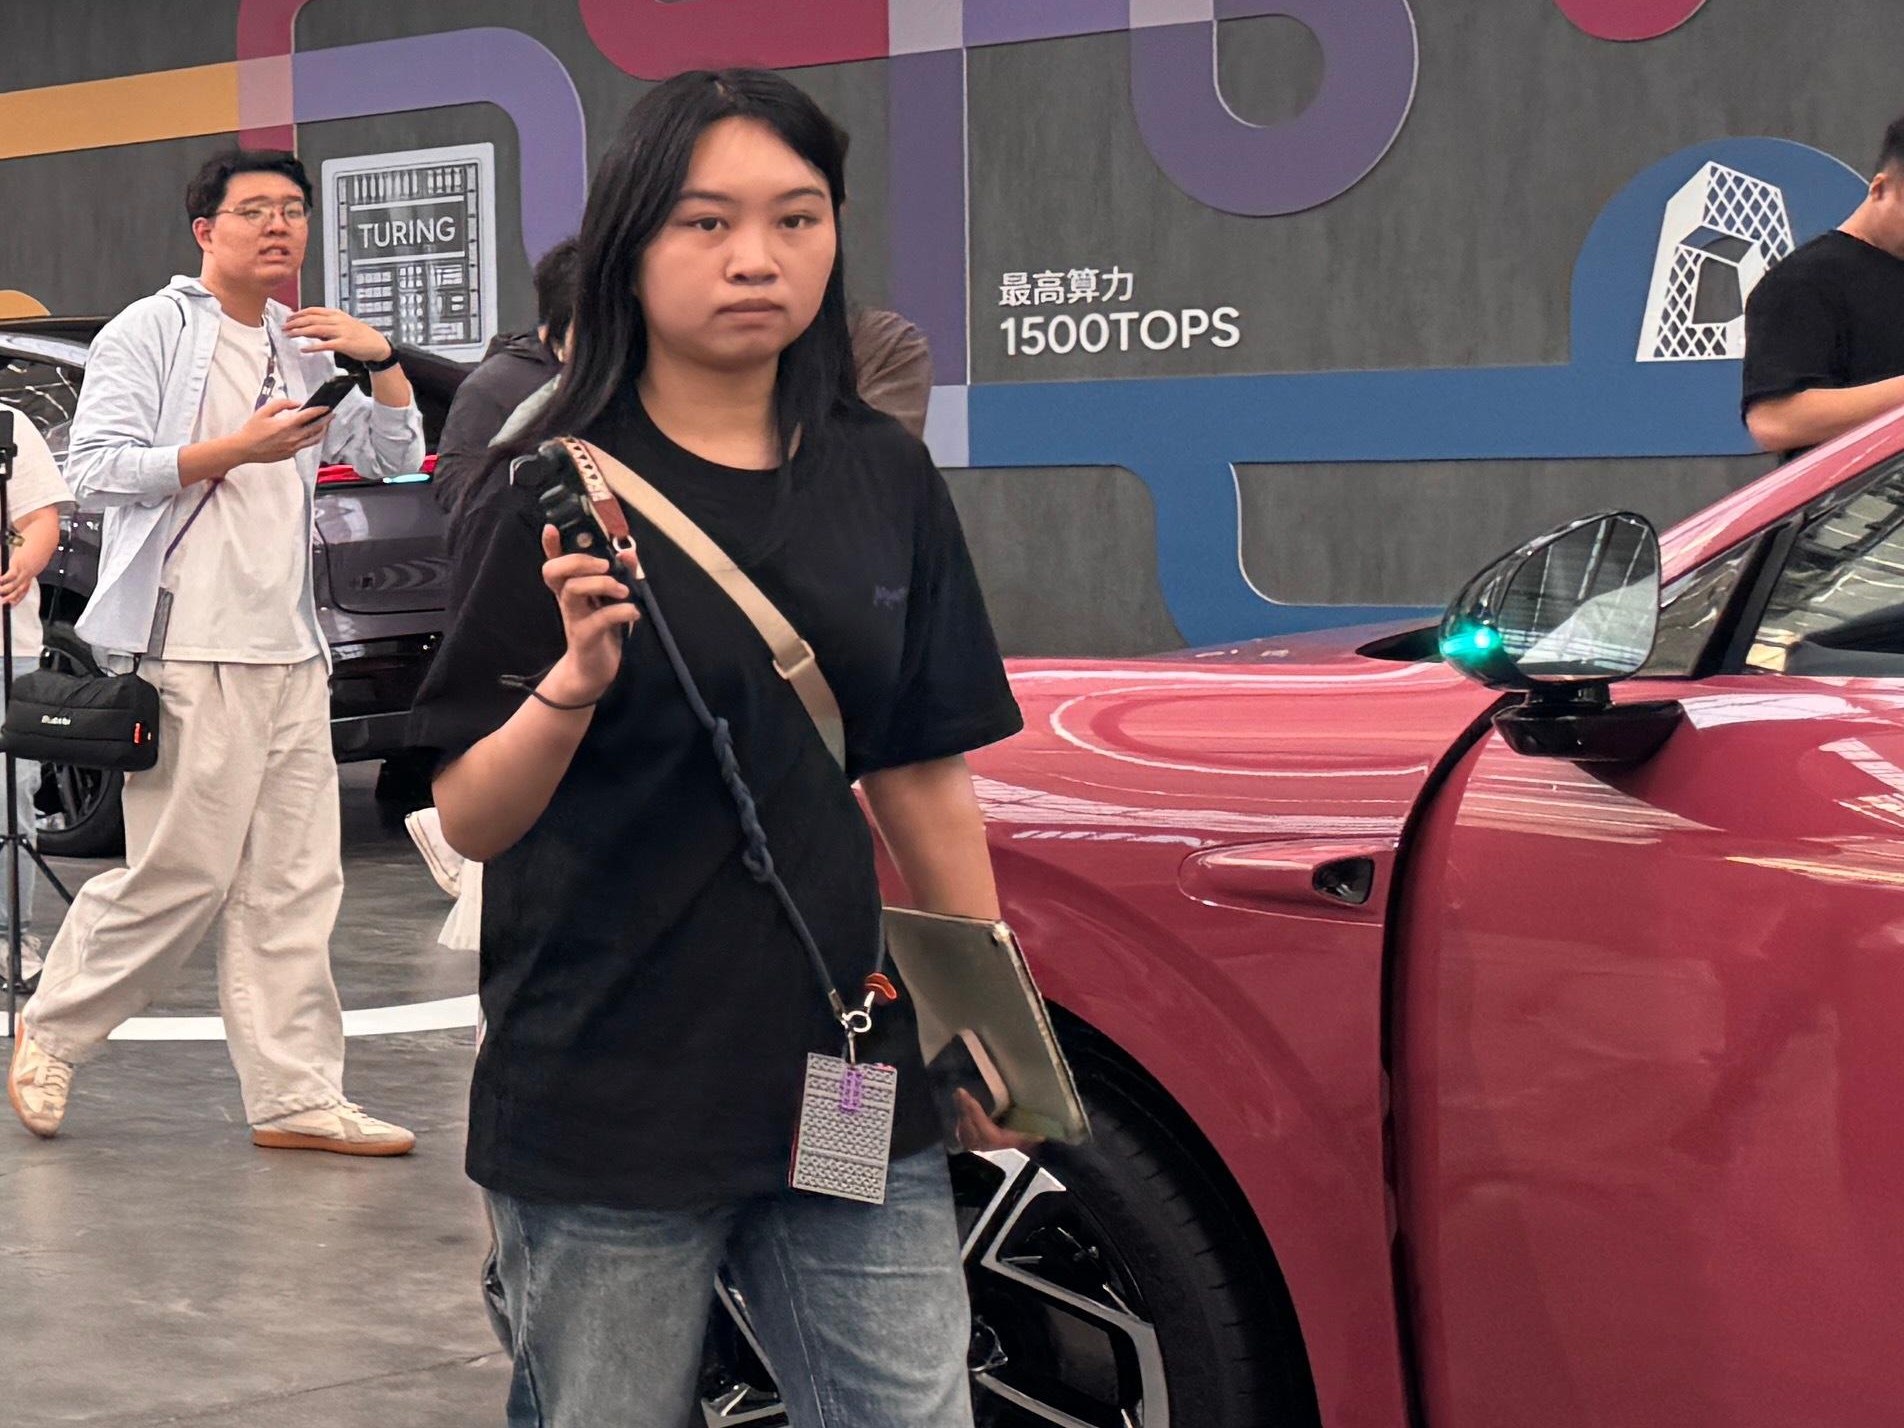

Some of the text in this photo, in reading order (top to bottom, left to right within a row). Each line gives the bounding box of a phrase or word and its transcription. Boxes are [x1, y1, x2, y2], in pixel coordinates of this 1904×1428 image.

[358, 216, 456, 248] TURING
[998, 266, 1134, 307] 最高算力
[1000, 306, 1240, 356] 1500TOPS
